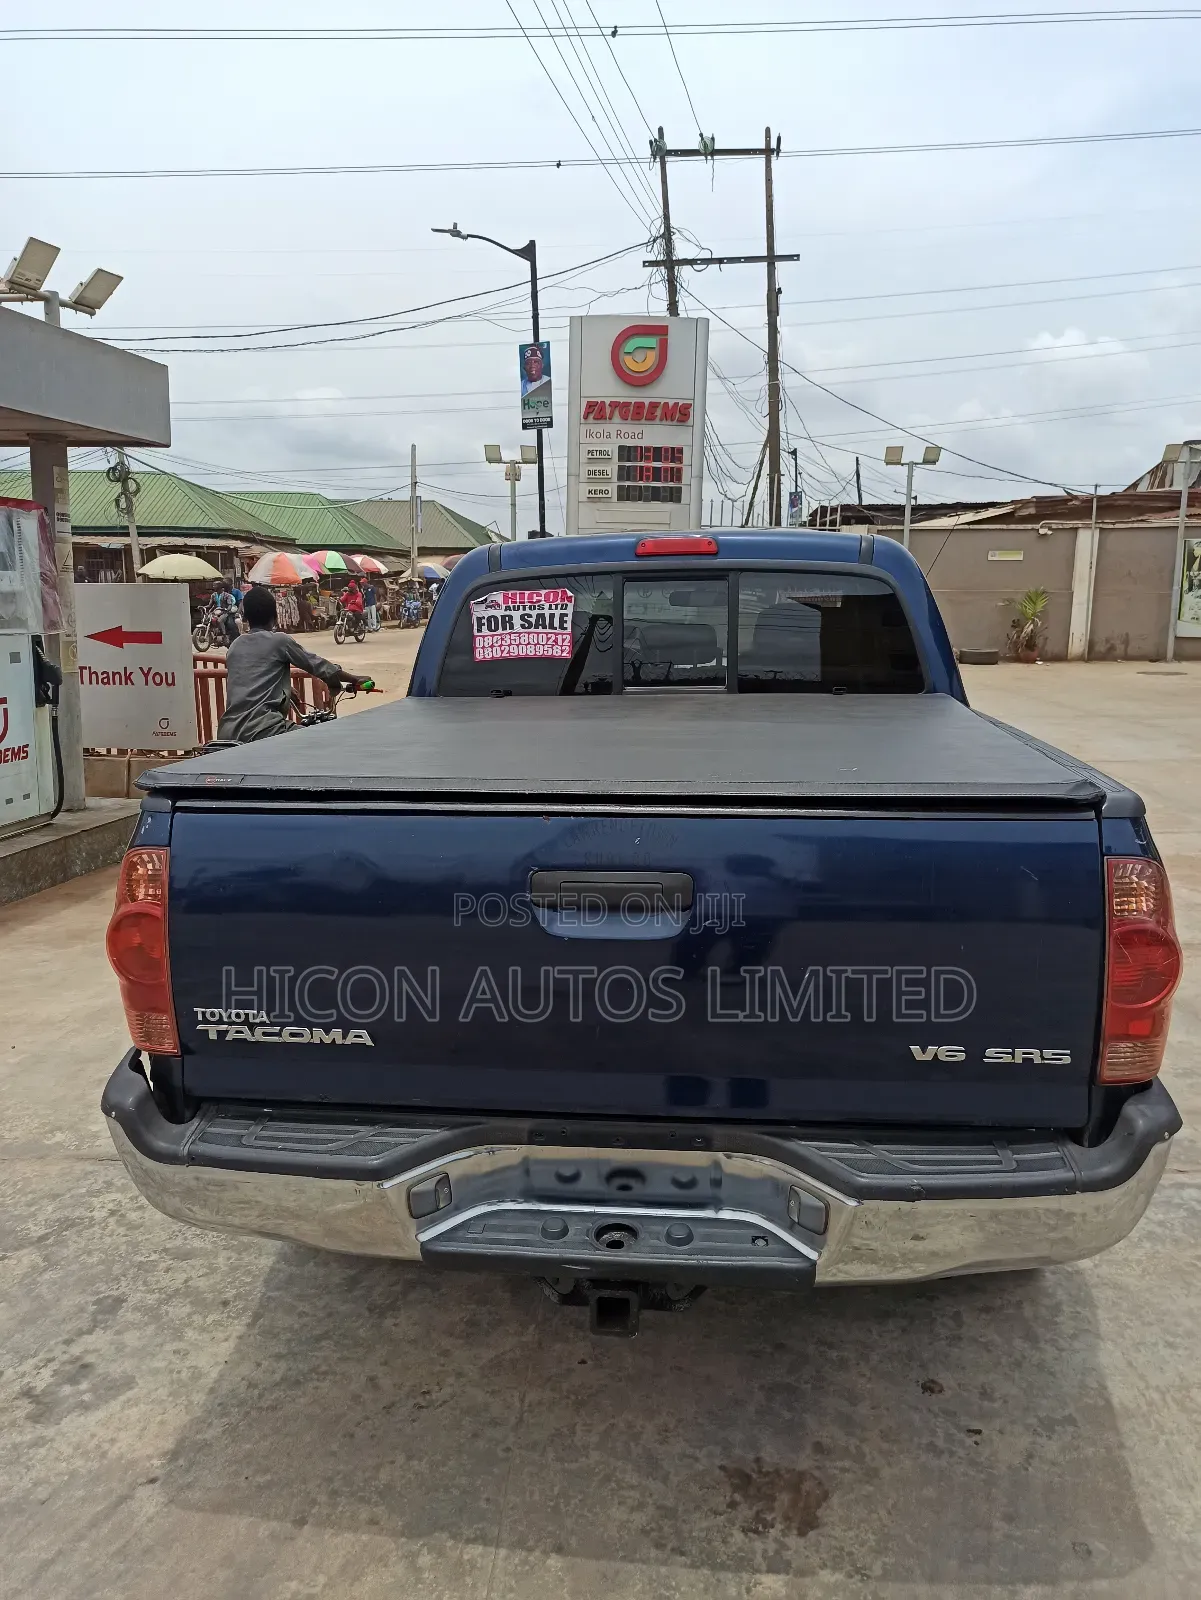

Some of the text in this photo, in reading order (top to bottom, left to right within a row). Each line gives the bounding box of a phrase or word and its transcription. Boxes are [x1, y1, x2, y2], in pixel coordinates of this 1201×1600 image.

[523, 399, 550, 410] Hope
[583, 401, 692, 422] FATGBEMS
[585, 429, 644, 440] Ikola Road
[587, 449, 611, 457] PETROL
[587, 469, 610, 477] DIESEL
[588, 488, 610, 496] KERO
[504, 603, 569, 612] AUTOS LTD
[476, 612, 569, 633] FOR SALE
[79, 666, 176, 687] Thank You
[193, 1007, 271, 1024] TOYOTA
[196, 1024, 375, 1047] TACOMA
[908, 1045, 1072, 1065] V6 SR5
